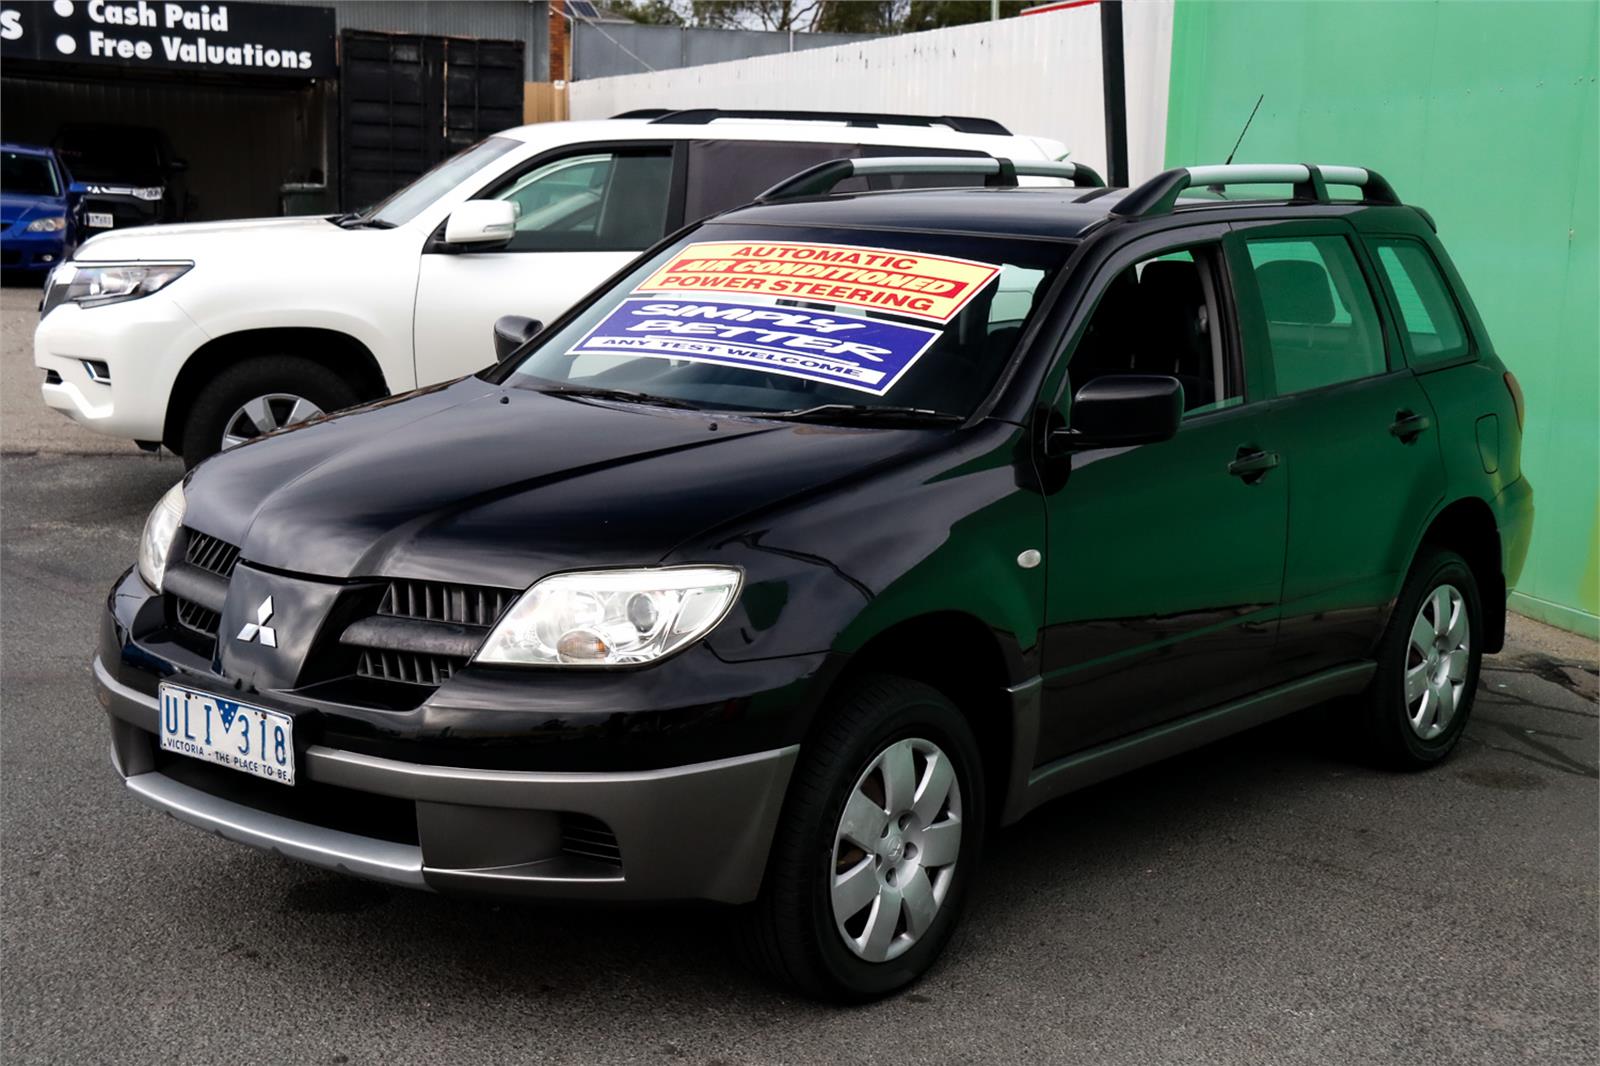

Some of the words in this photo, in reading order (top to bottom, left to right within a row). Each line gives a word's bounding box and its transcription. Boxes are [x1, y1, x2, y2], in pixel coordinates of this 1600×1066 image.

[88, 1, 156, 27] Cash
[165, 4, 228, 31] Paid
[89, 31, 153, 60] Free
[161, 36, 312, 69] Valuations
[732, 246, 918, 270] AUTOMATIC
[658, 276, 767, 290] POWER
[769, 278, 934, 311] STEERING
[676, 259, 737, 272] AIR
[733, 260, 956, 293] CONDITIONED
[632, 303, 866, 333] SIMPLY
[626, 319, 892, 362] BETTER
[659, 341, 721, 352] TEST
[727, 348, 863, 377] WELCOME
[238, 714, 287, 767] 318
[166, 738, 204, 755] VICTORIA
[215, 750, 230, 763] THE
[234, 757, 258, 772] PLACE
[263, 764, 273, 776] TO
[277, 770, 287, 780] BE
